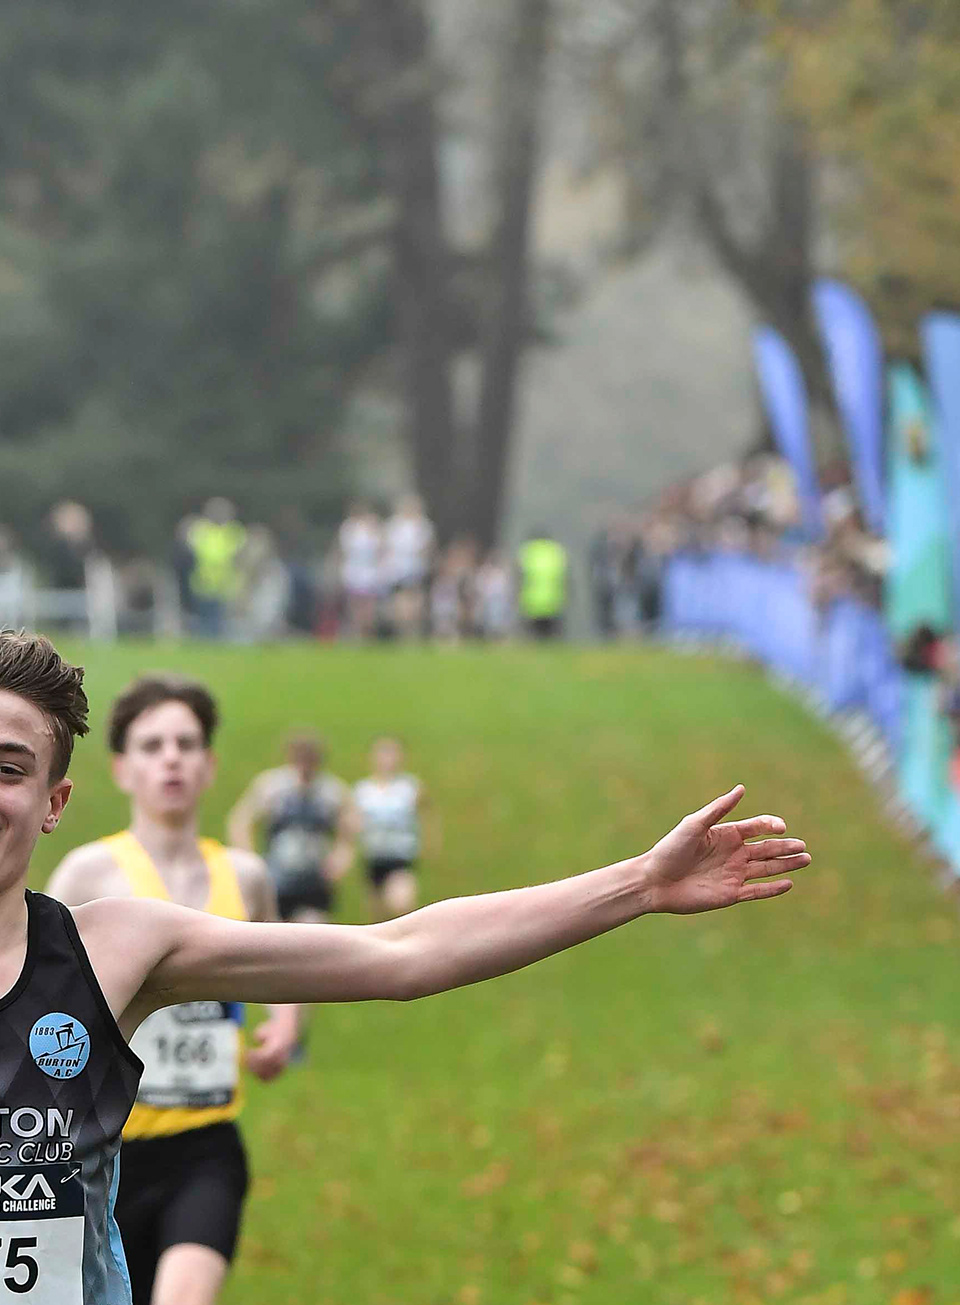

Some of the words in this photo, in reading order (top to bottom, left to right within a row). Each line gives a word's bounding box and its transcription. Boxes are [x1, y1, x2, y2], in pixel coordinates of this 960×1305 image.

[34, 1027, 56, 1036] 1883
[37, 1057, 80, 1068] BURTON
[18, 1142, 74, 1163] CLUB
[2, 1198, 57, 1212] CHALLENGE
